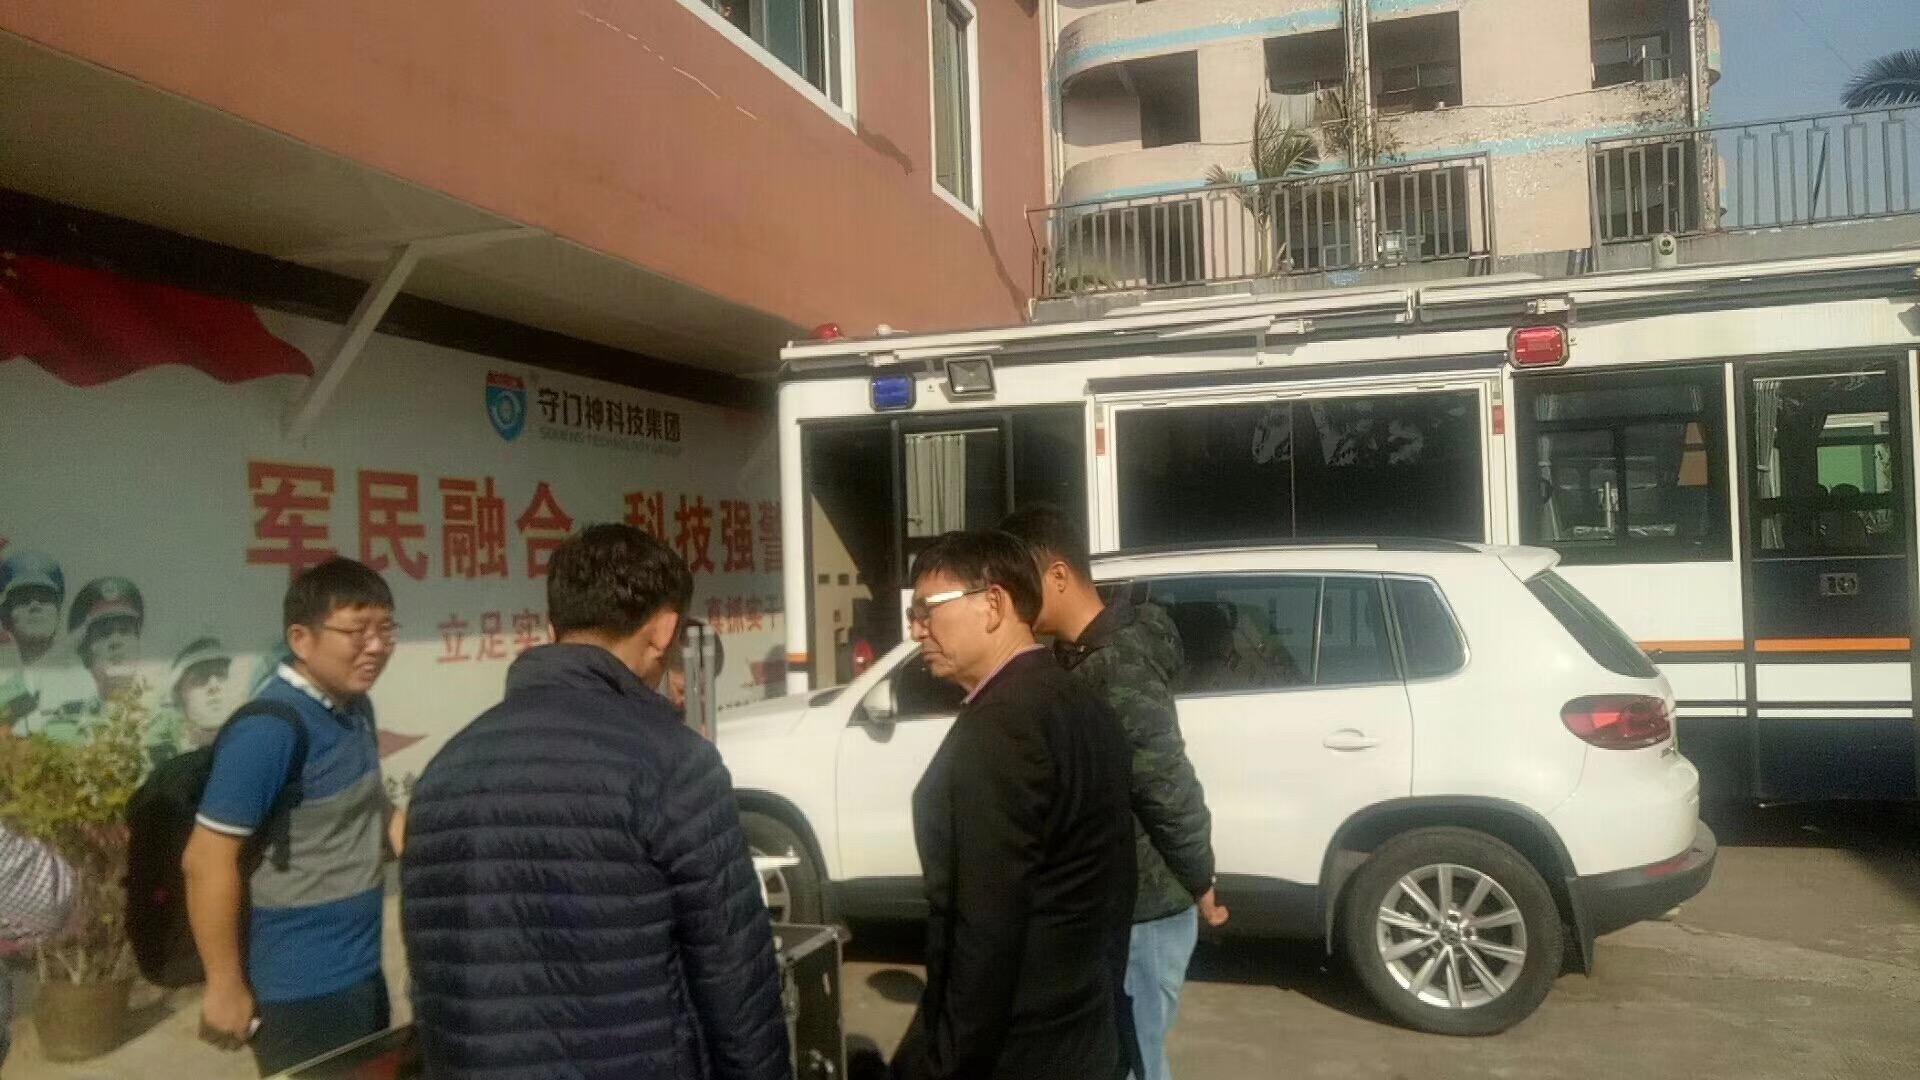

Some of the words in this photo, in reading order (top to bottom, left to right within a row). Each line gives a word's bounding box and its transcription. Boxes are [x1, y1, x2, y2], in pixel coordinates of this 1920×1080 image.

[537, 388, 681, 442] 守门神科技集团
[246, 462, 574, 581] 军民融合
